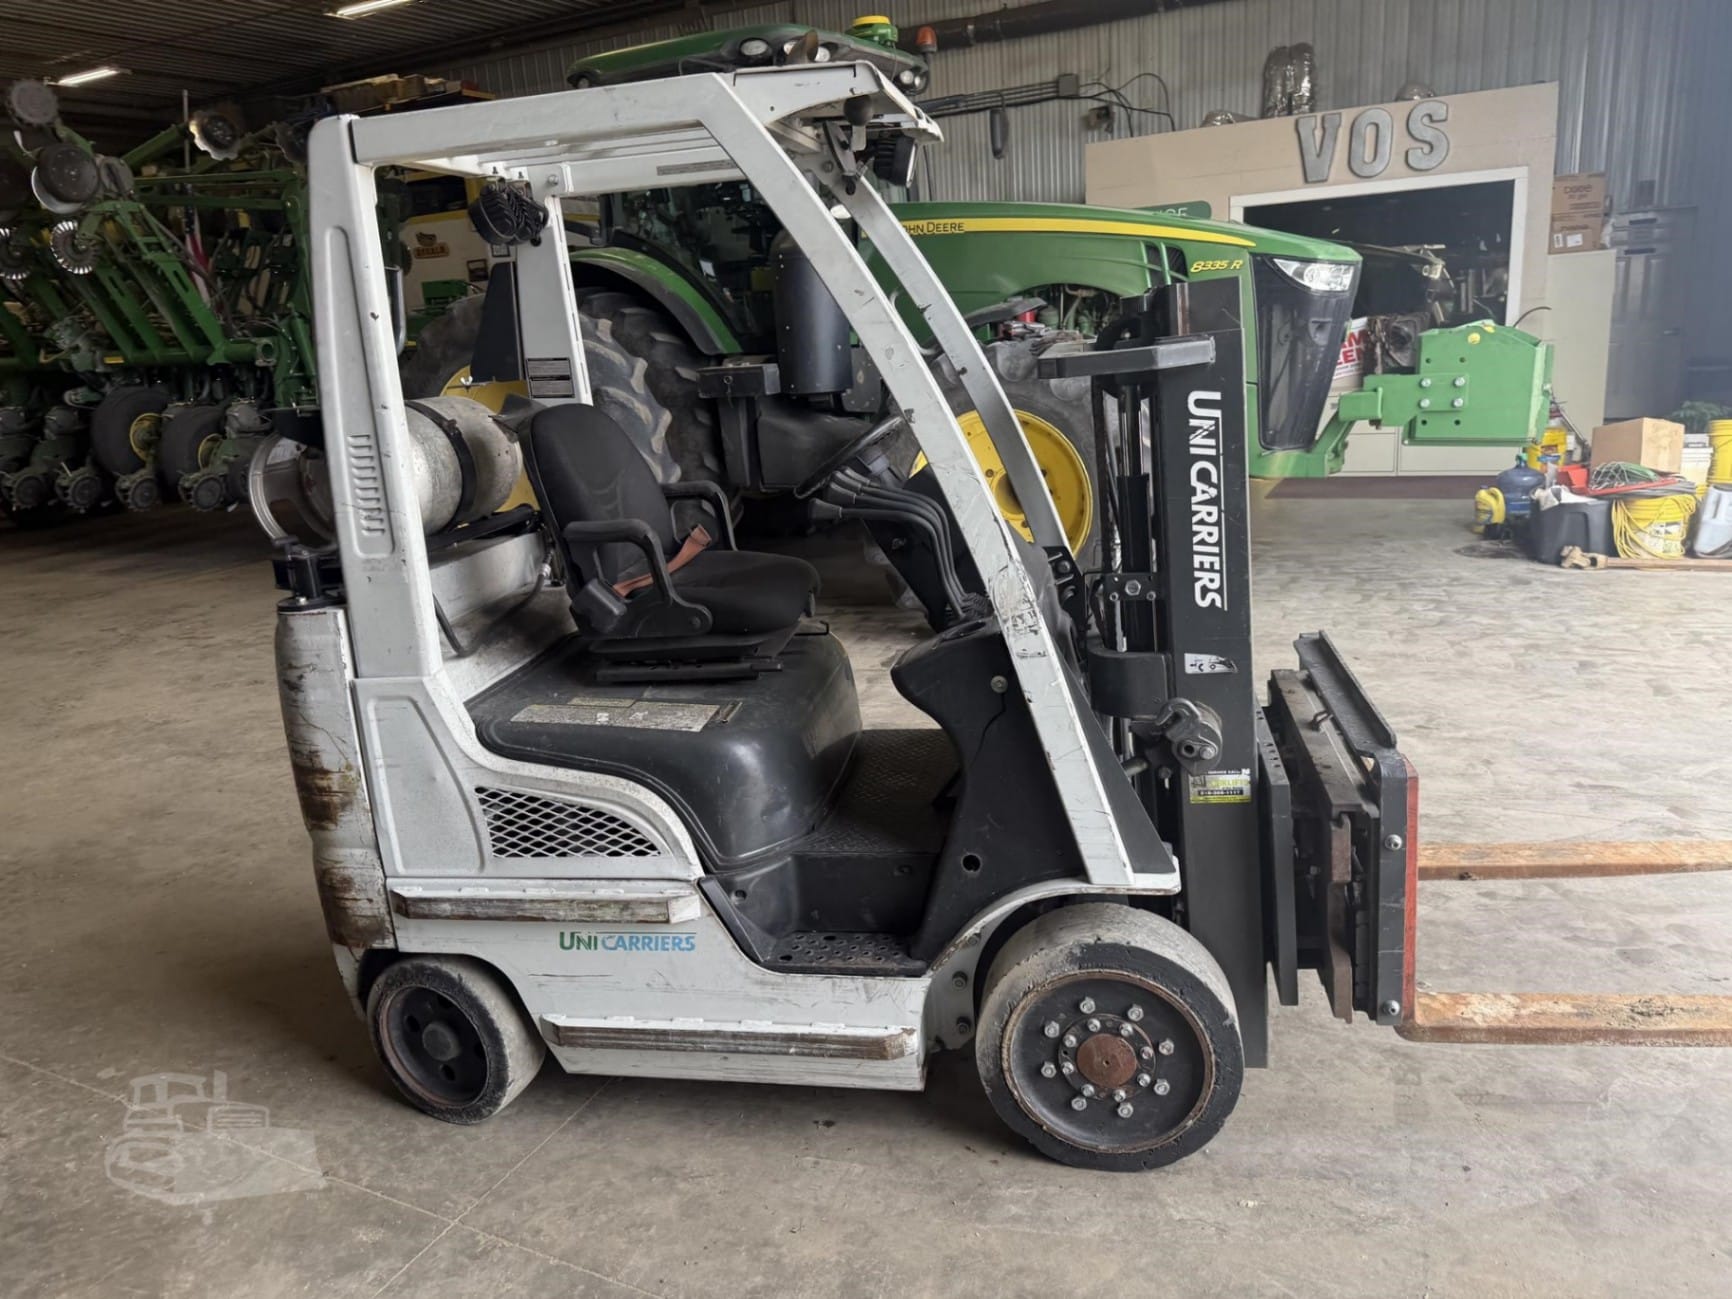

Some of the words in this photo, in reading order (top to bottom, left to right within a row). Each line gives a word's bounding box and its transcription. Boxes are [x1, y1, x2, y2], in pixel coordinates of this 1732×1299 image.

[1295, 100, 1449, 184] VOS
[1190, 260, 1229, 273] 8335
[1230, 259, 1243, 270] R
